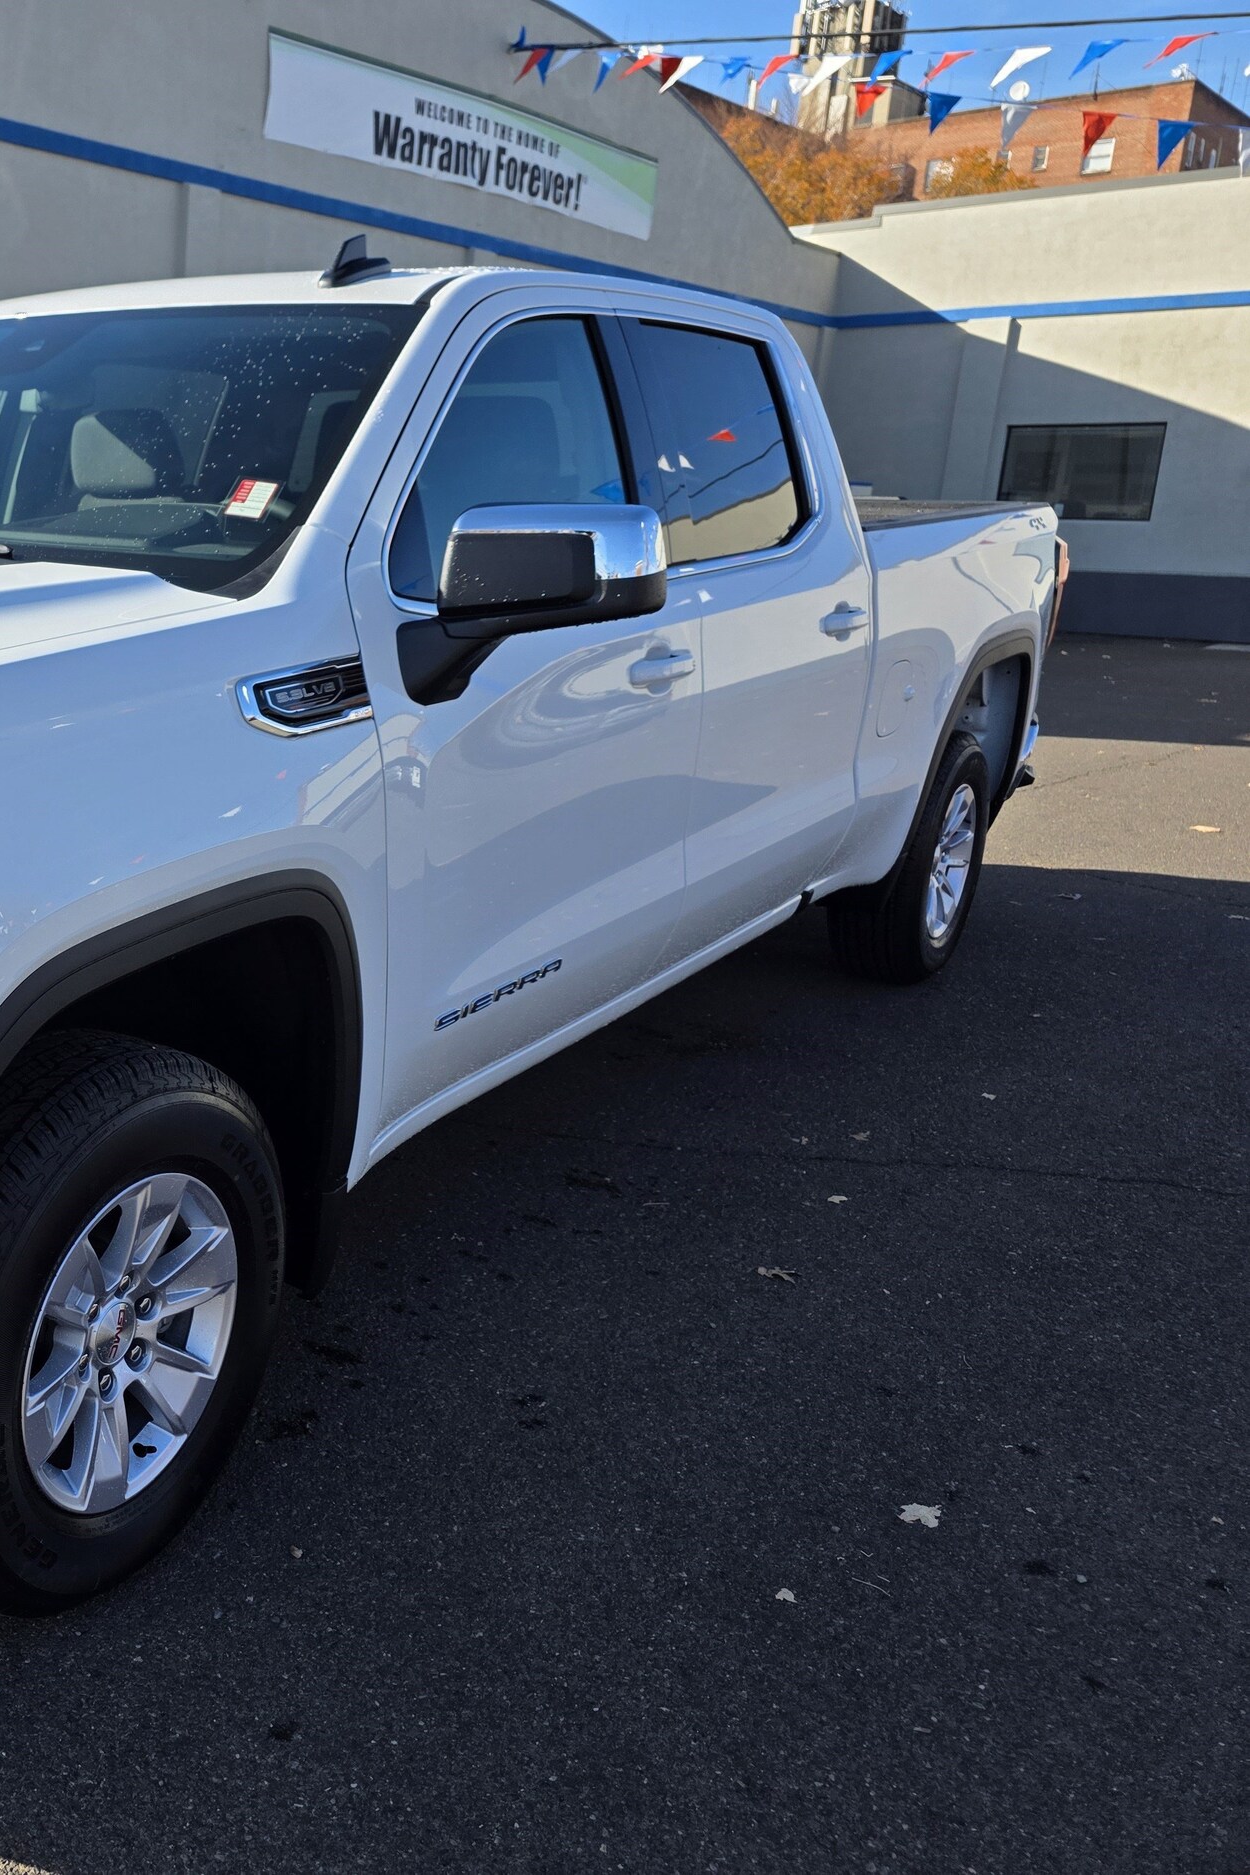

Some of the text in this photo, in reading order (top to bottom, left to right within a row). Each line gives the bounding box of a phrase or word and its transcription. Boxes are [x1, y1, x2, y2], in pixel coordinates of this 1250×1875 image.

[373, 110, 583, 211] Warranty Forever!
[414, 97, 561, 159] WELCOME TO THE HOME OF
[434, 958, 562, 1031] SIERRA
[108, 1308, 126, 1359] GMC
